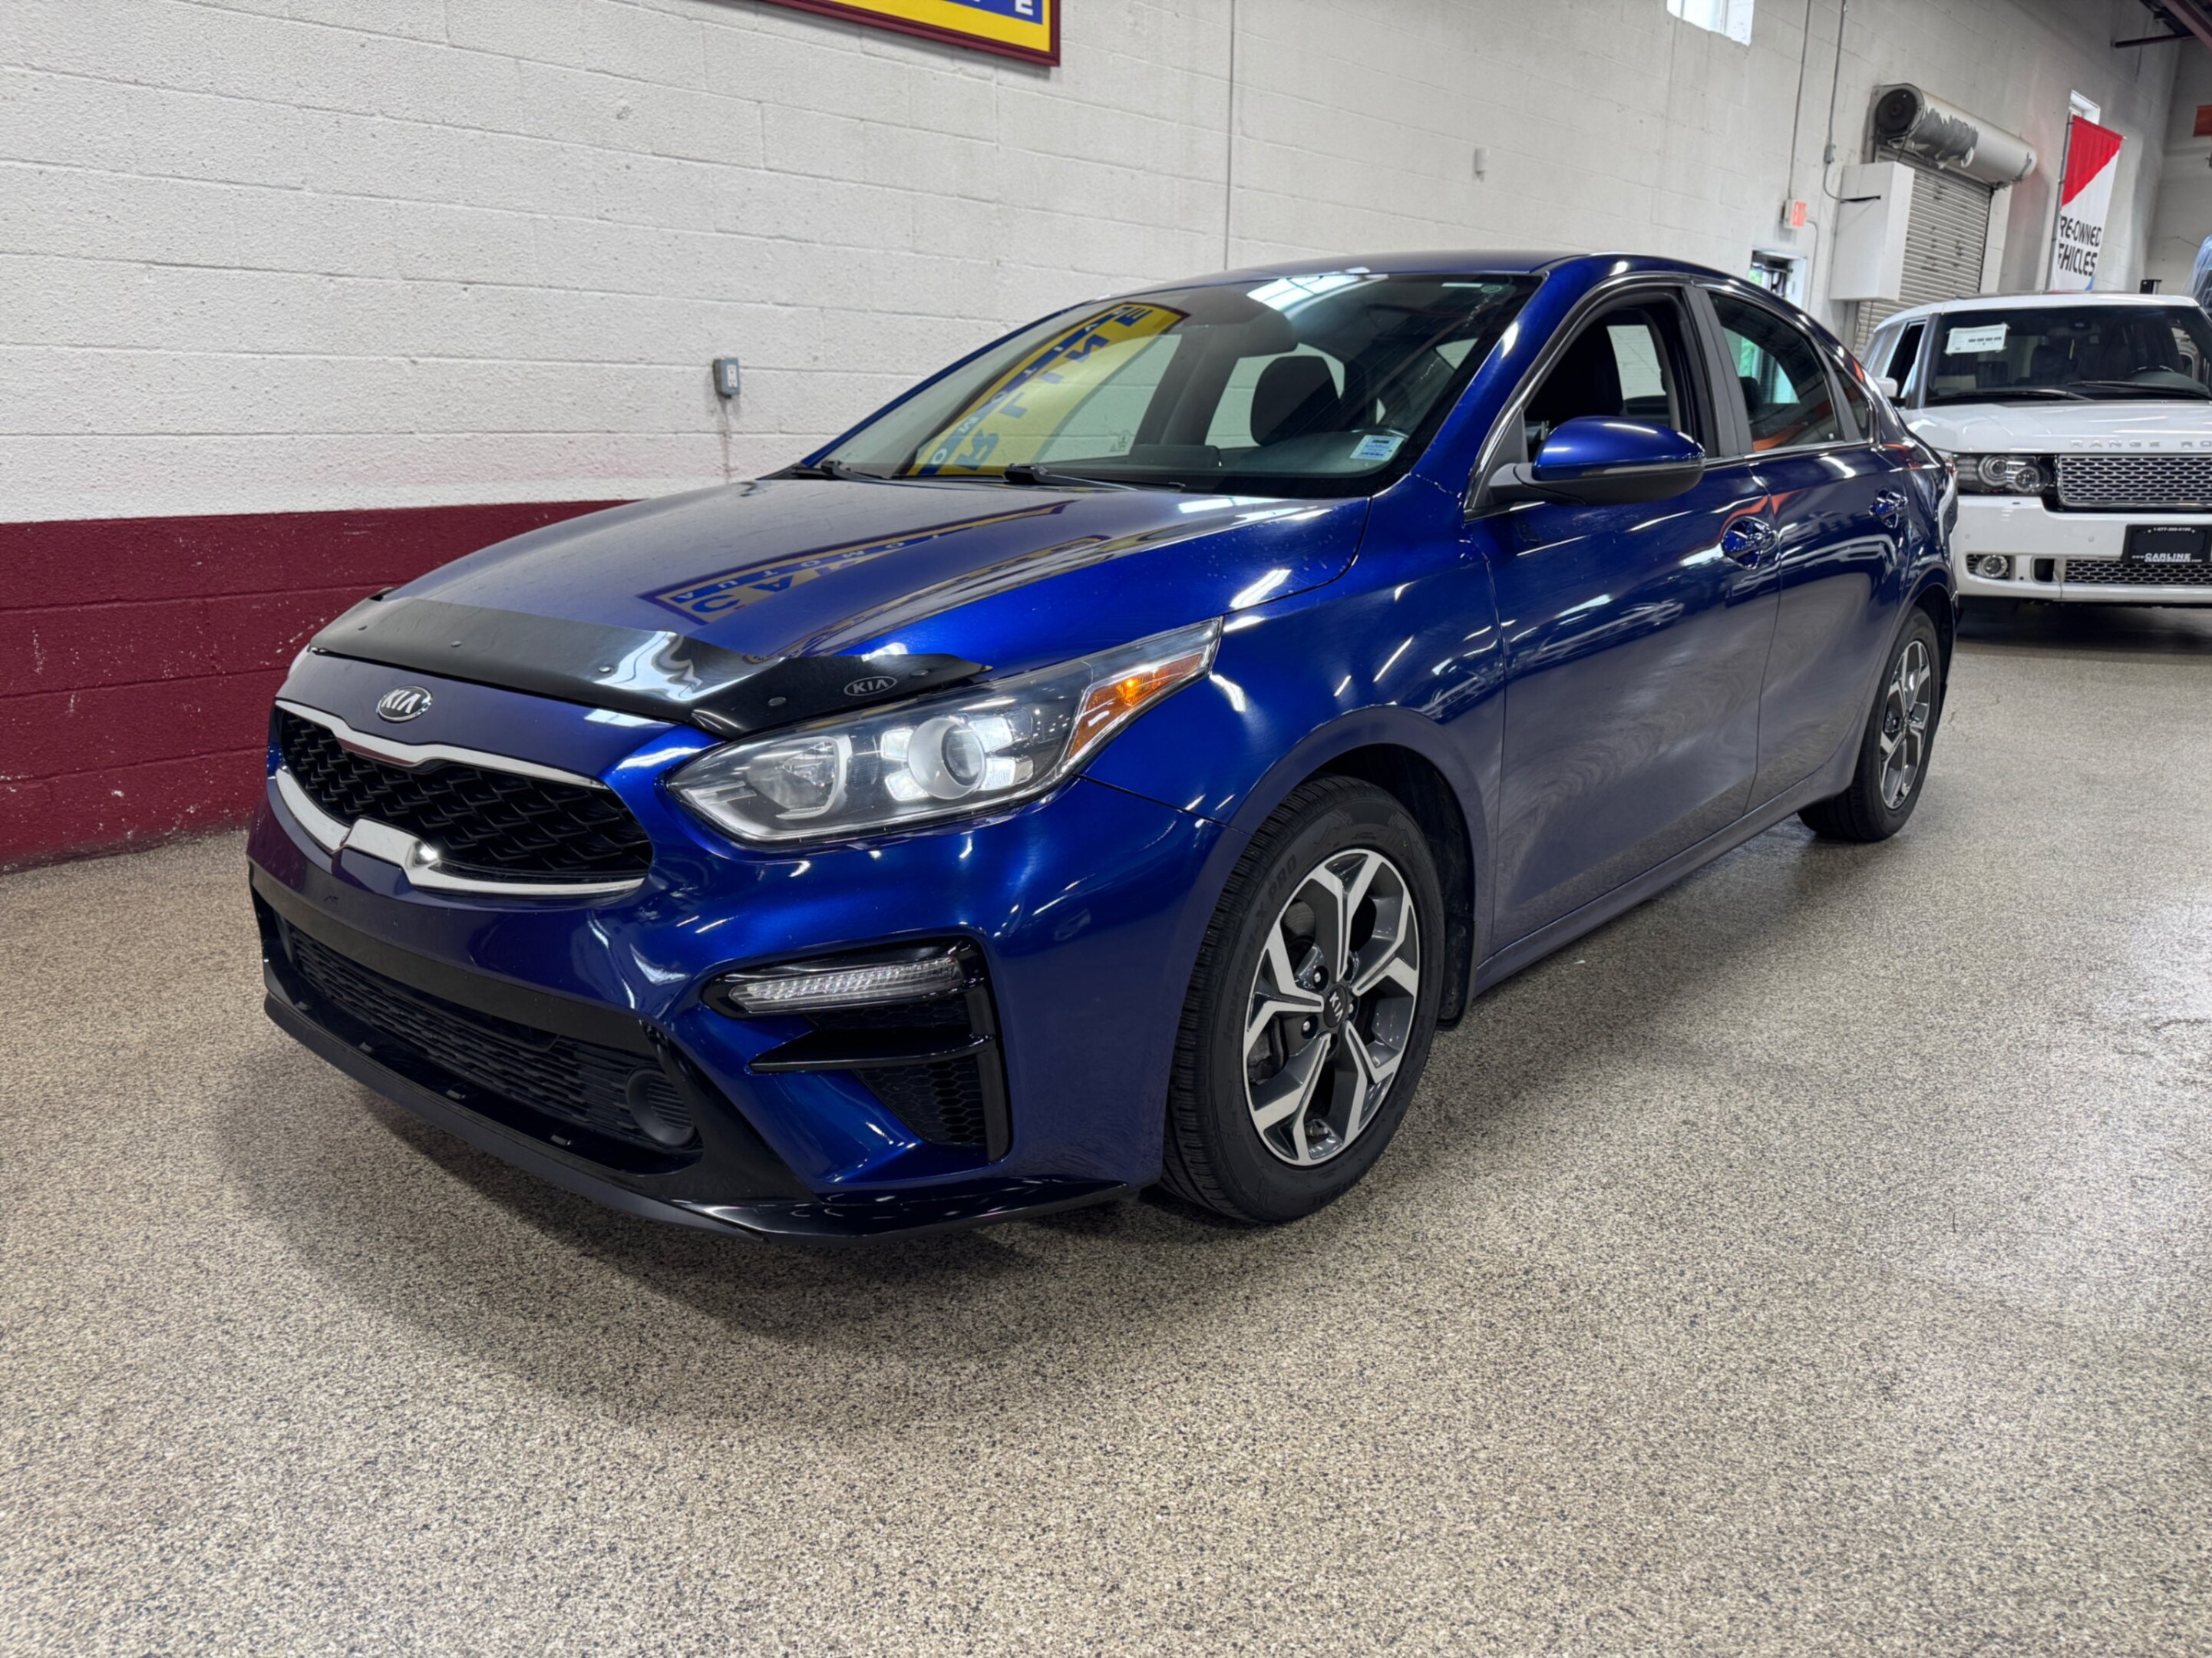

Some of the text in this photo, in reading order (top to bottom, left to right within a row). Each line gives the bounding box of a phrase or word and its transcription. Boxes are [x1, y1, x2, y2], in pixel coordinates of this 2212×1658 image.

[2070, 439, 2161, 448] RANGE
[853, 679, 889, 694] KIA
[381, 689, 421, 714] KIA
[1329, 991, 1343, 1022] KIA
